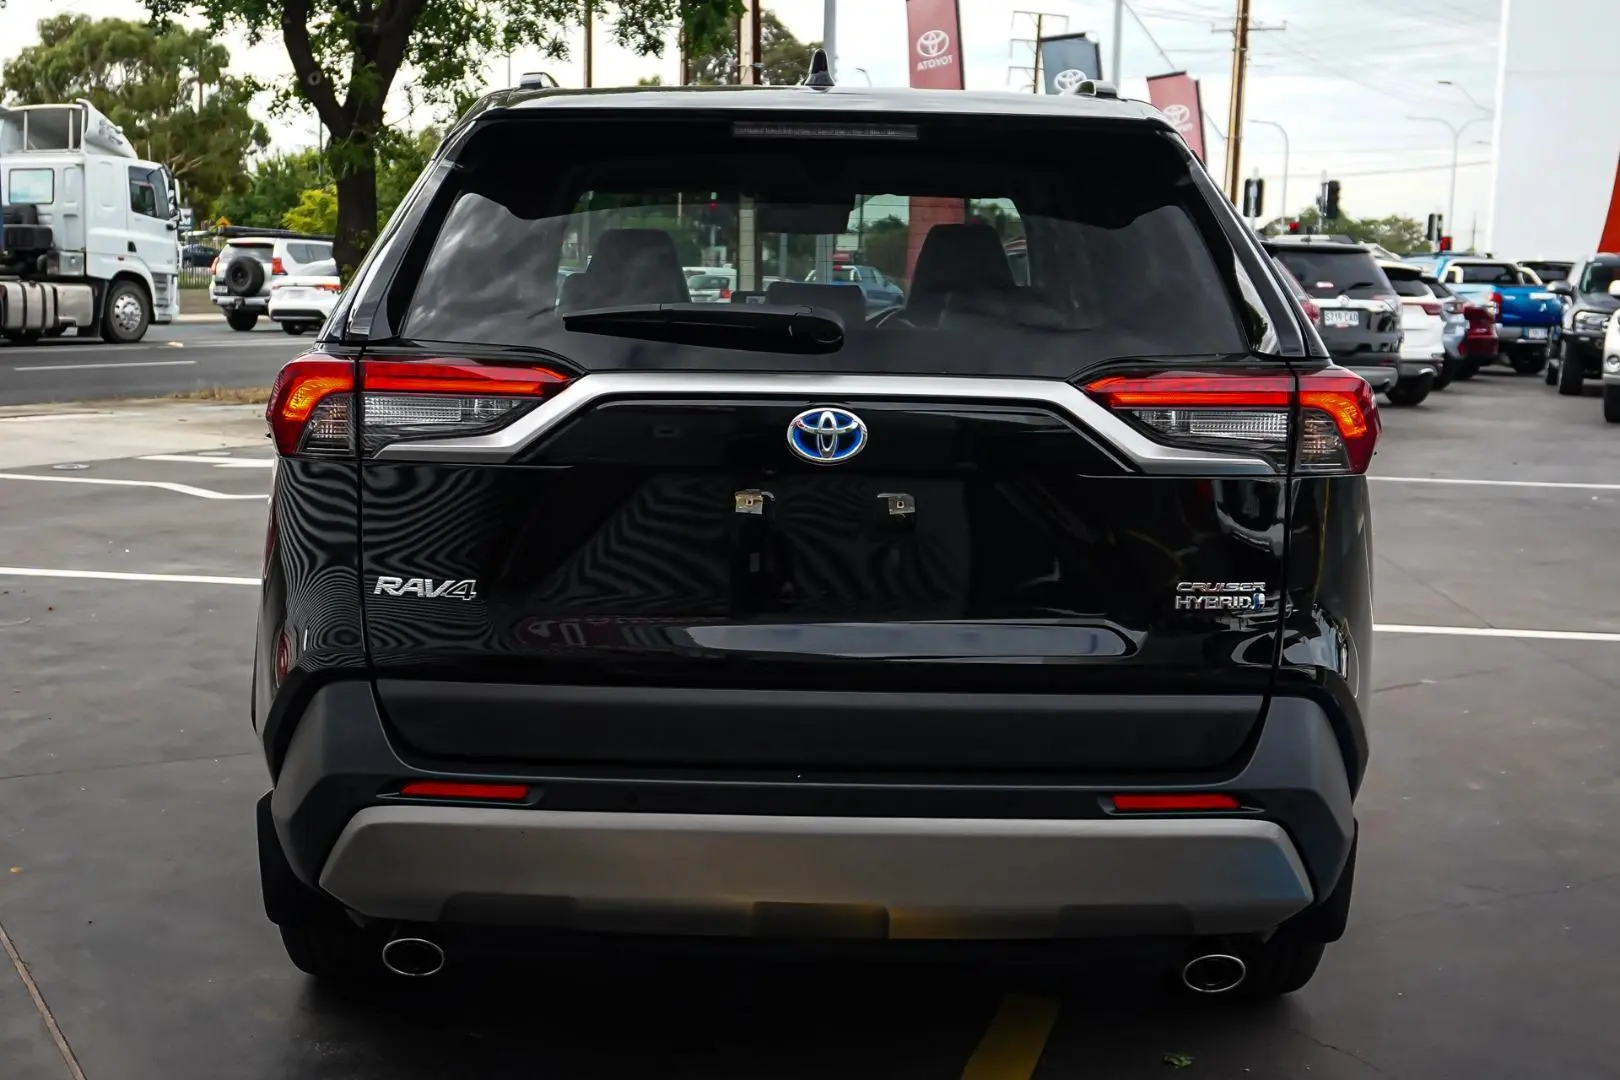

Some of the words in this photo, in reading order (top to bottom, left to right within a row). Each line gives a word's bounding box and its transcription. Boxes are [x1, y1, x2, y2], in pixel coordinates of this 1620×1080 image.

[373, 576, 477, 600] RAV4
[1176, 582, 1266, 592] CRUISER
[1175, 595, 1252, 609] HYBRID
